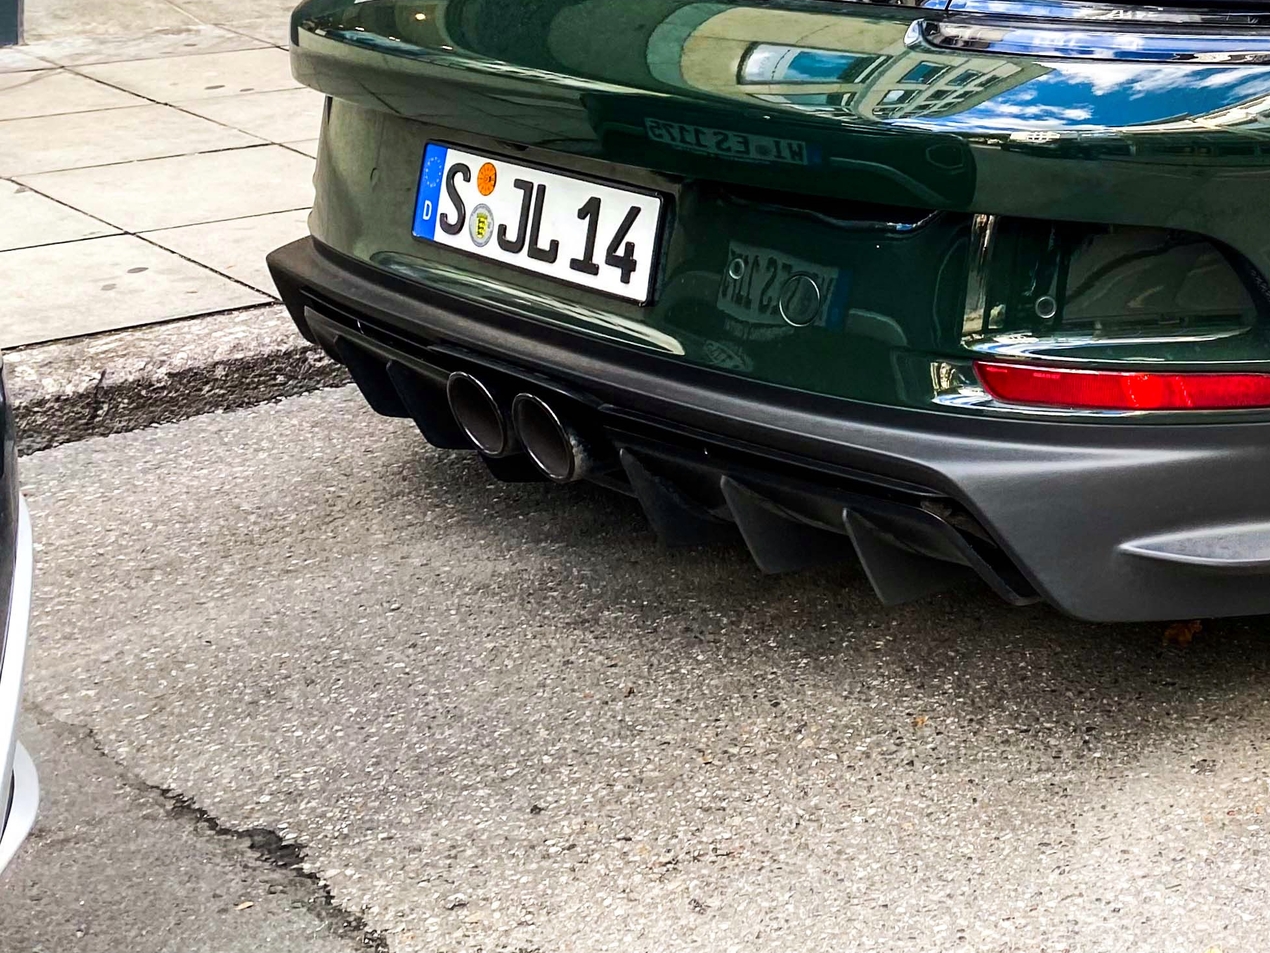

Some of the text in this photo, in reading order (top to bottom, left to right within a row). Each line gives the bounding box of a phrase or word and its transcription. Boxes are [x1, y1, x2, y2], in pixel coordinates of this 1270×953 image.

[422, 200, 433, 221] D
[440, 162, 642, 284] S JL 14
